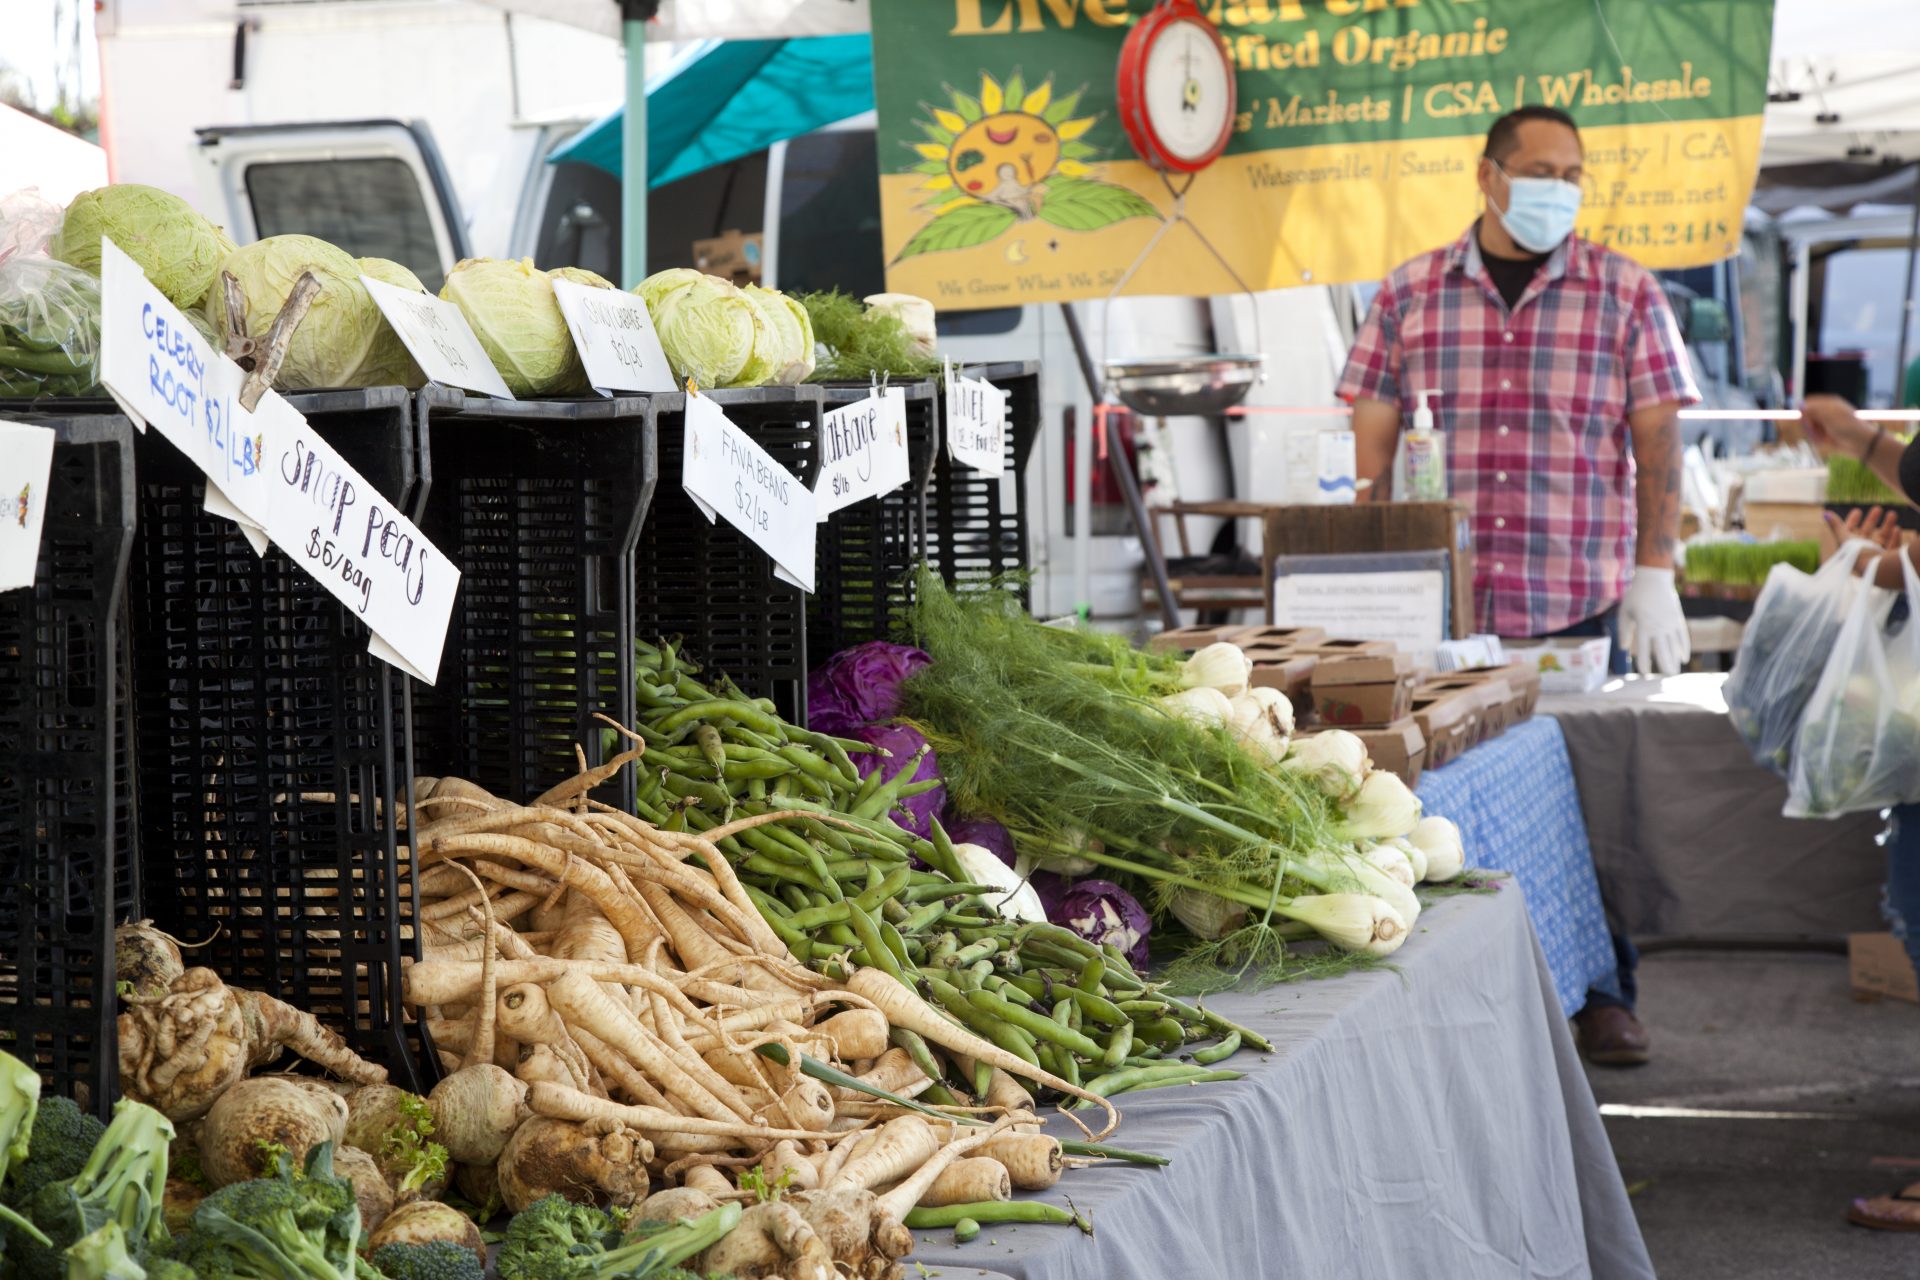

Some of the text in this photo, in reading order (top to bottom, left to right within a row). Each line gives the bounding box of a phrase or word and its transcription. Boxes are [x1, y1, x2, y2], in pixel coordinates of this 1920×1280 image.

[1221, 17, 1509, 70] fied Organic
[1265, 90, 1391, 129] Markets
[1423, 80, 1501, 119] CSA
[1538, 61, 1712, 107] Wholesale
[1400, 151, 1465, 177] Santa
[1583, 143, 1649, 173] unty
[1681, 132, 1732, 161] CA
[142, 302, 205, 398] CELERY
[150, 353, 197, 427] ROOT
[722, 429, 789, 506] FAVA BEANS
[822, 407, 877, 482] abbage
[734, 474, 769, 533] $2/LB
